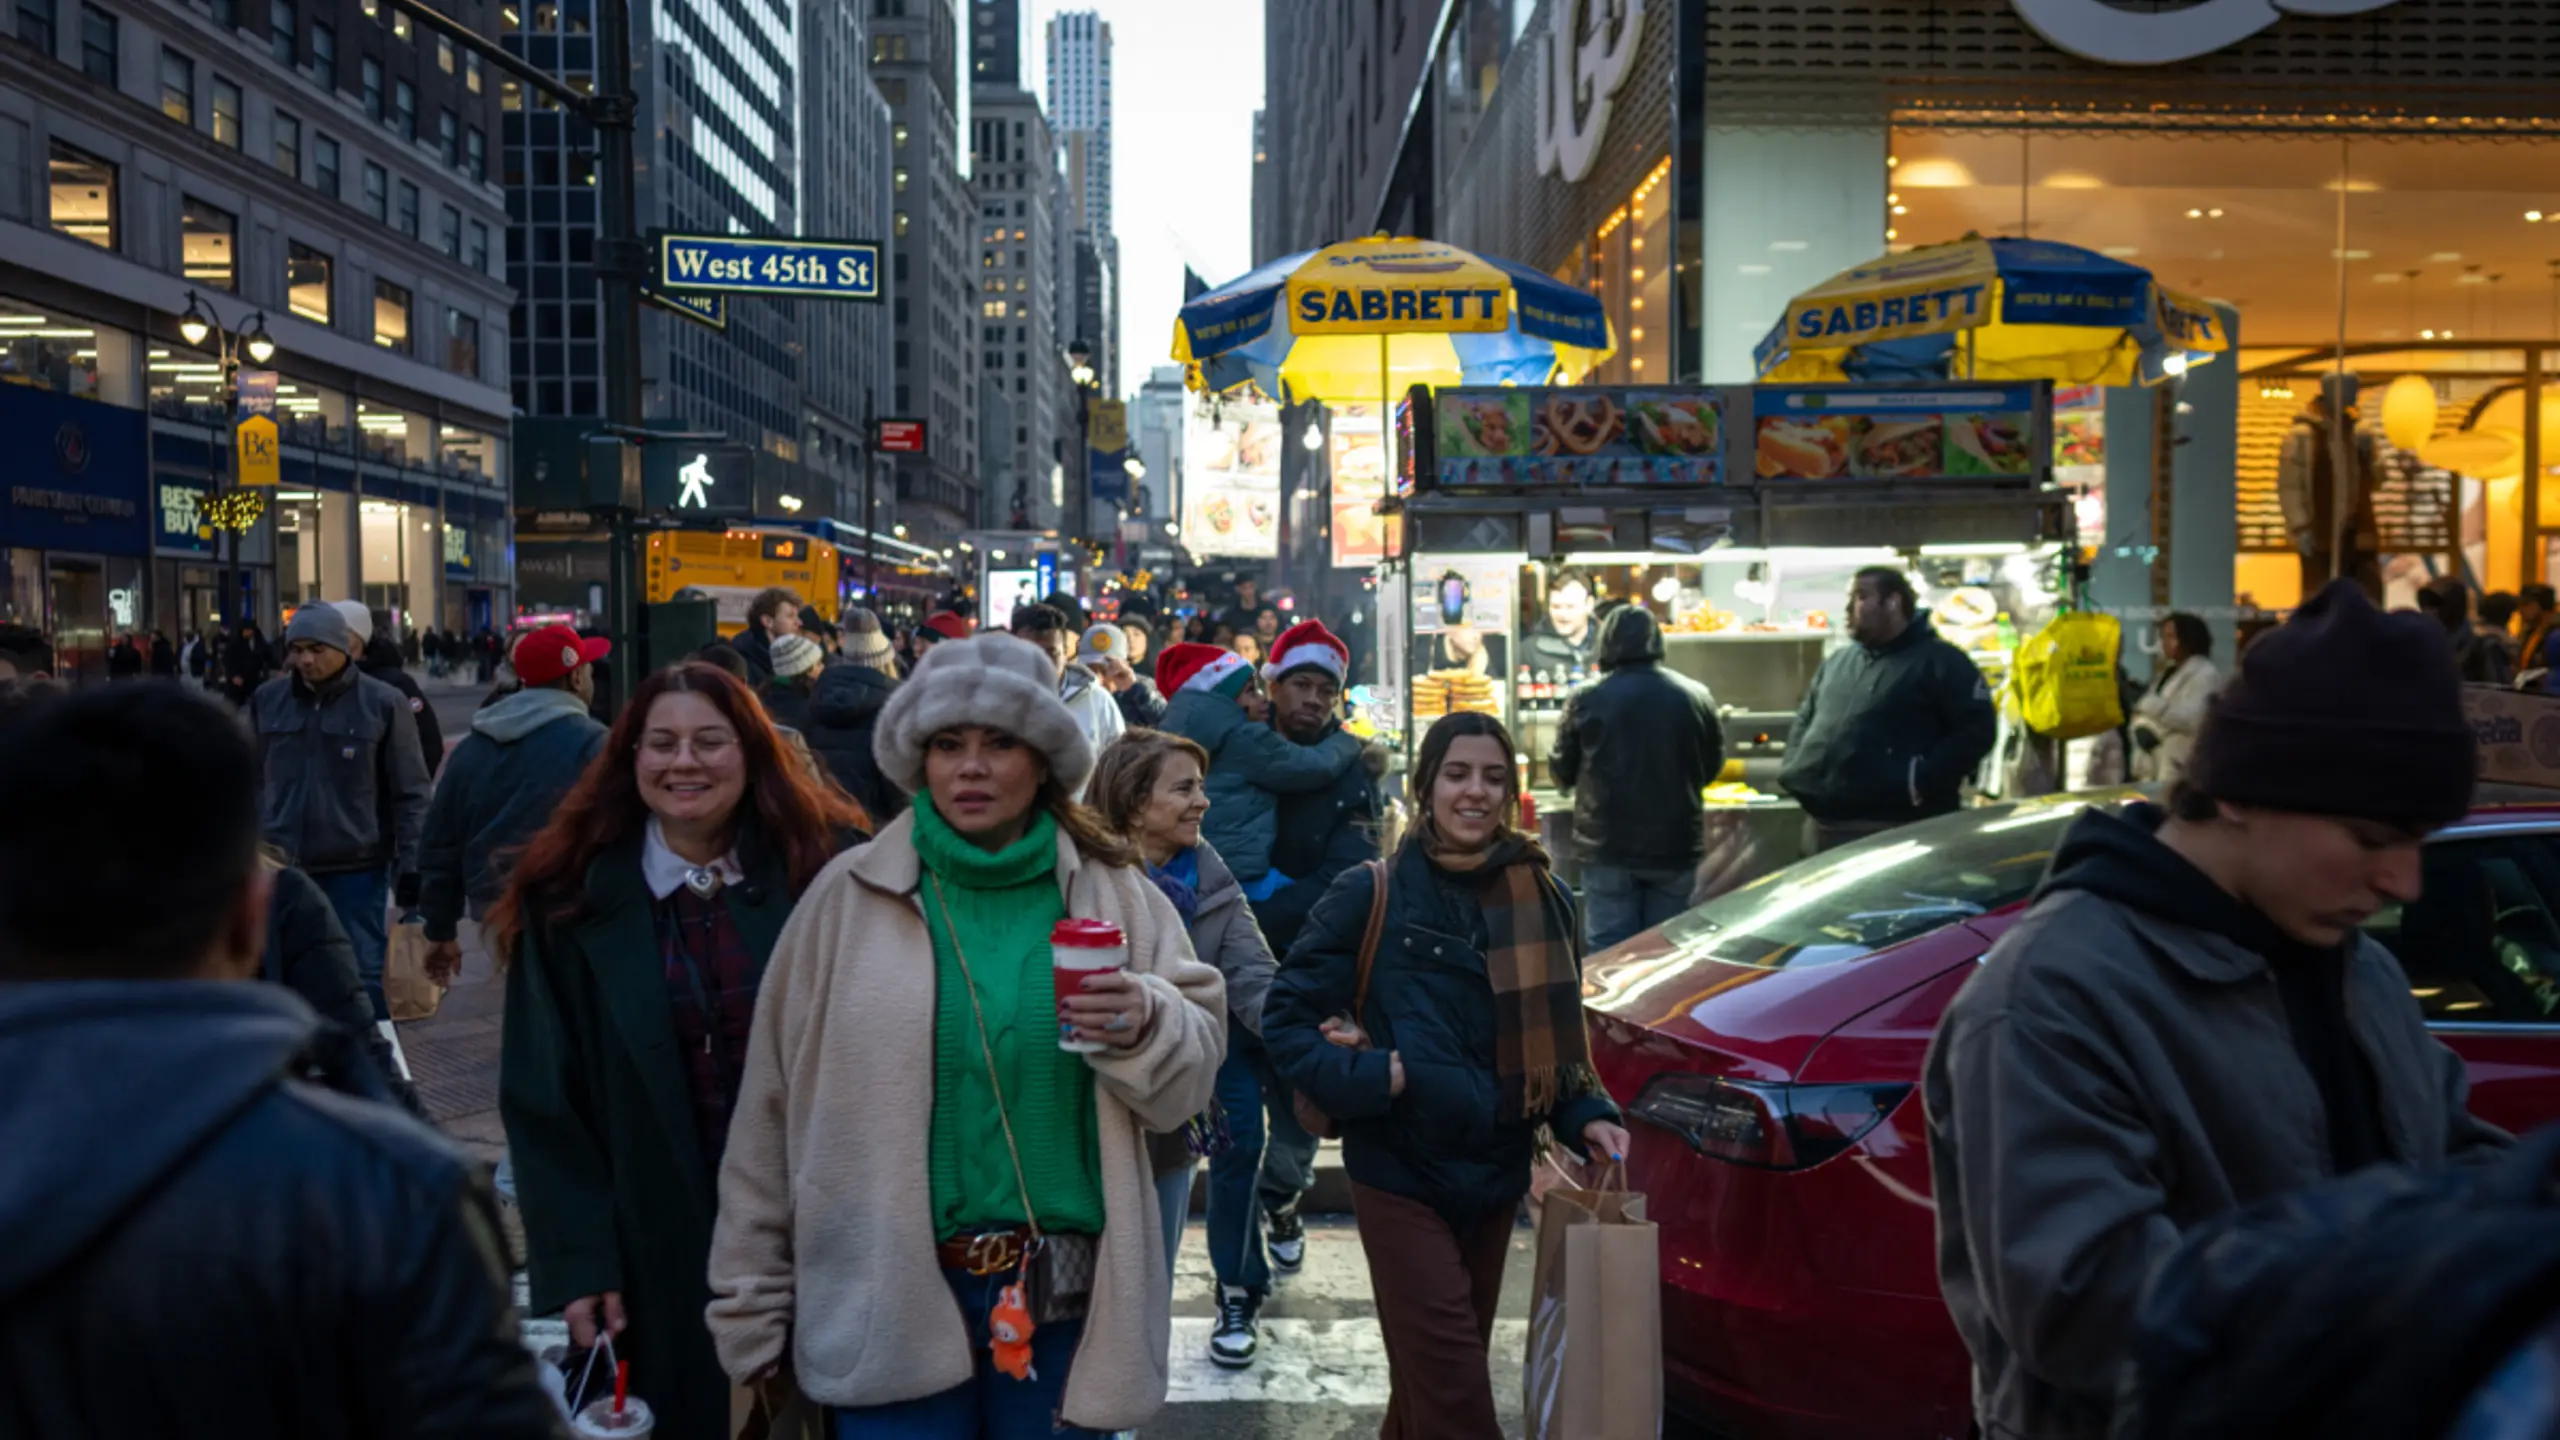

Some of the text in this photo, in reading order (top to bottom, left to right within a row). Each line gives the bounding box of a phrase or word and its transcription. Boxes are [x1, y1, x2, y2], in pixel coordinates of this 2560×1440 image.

[673, 248, 871, 288] West 45th St
[1299, 288, 1502, 322] SABRETT
[1797, 283, 1986, 339] SABRETT
[165, 509, 201, 536] BUY
